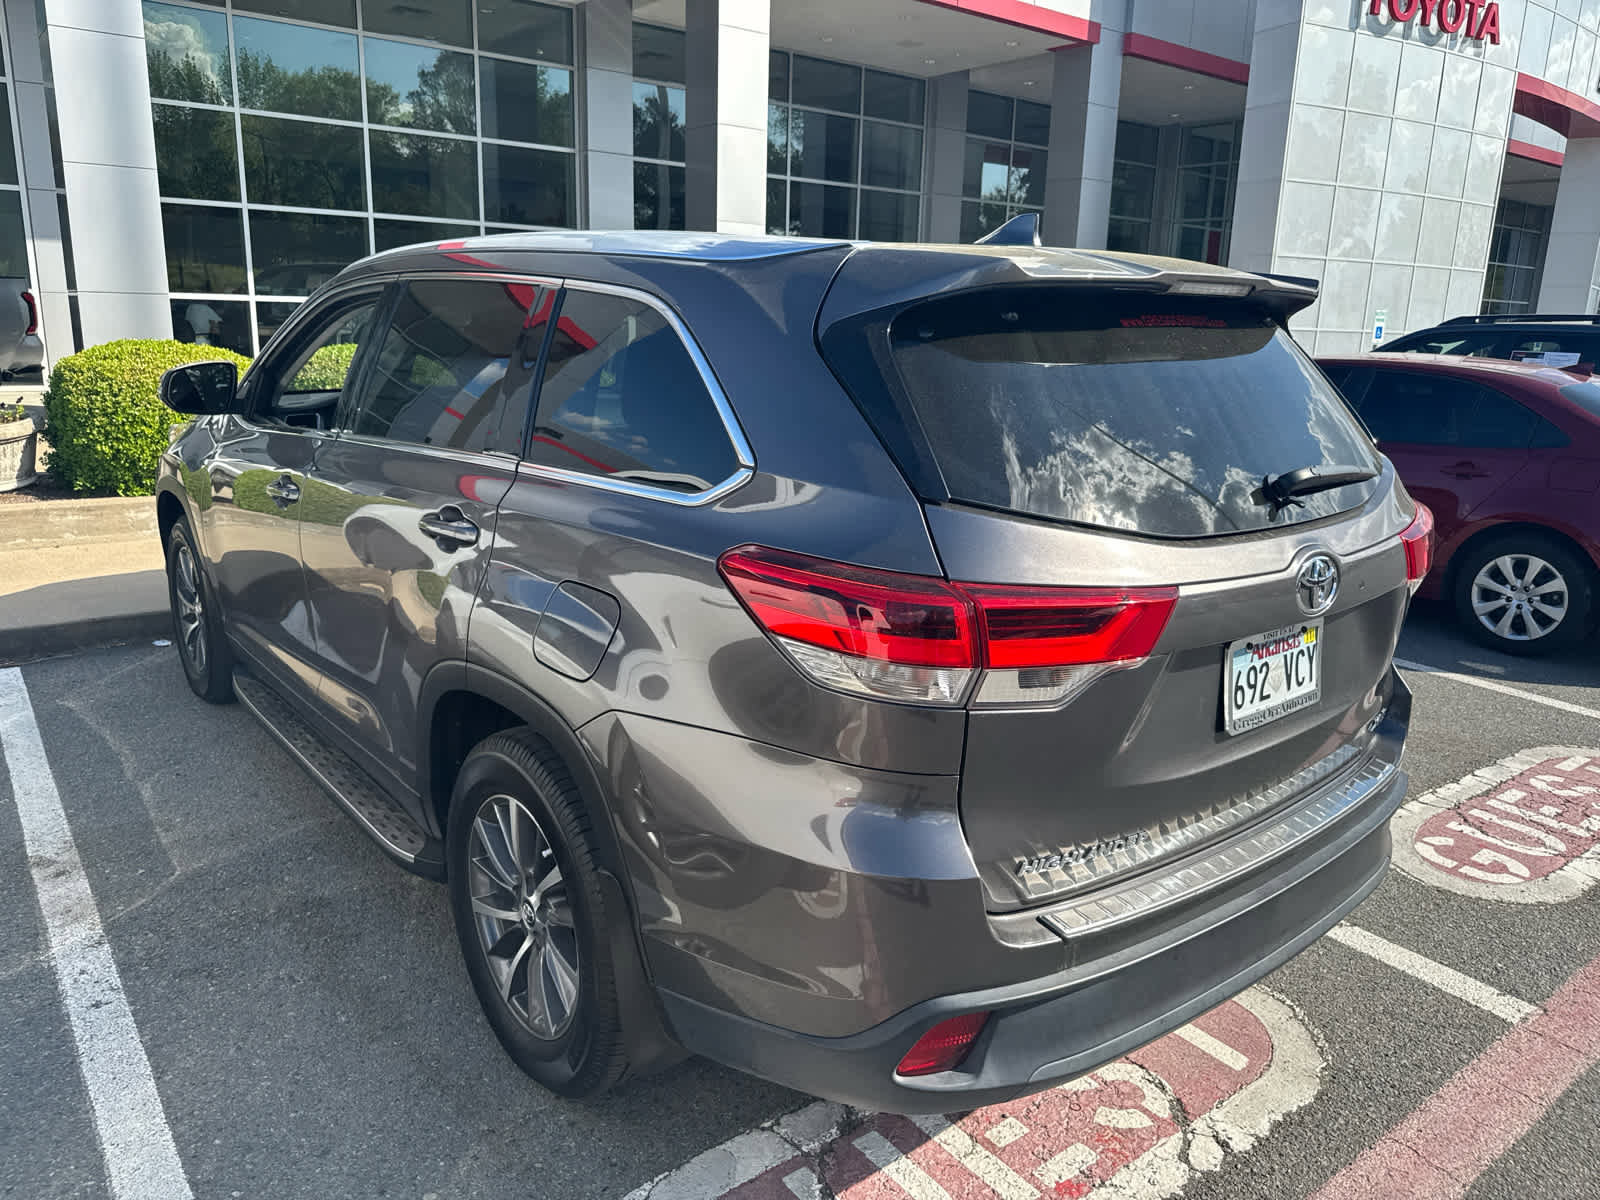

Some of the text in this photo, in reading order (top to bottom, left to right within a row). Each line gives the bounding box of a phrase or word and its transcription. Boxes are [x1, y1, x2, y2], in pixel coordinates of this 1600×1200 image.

[1251, 631, 1303, 662] Arkansas
[1234, 644, 1317, 710] 692 VCY
